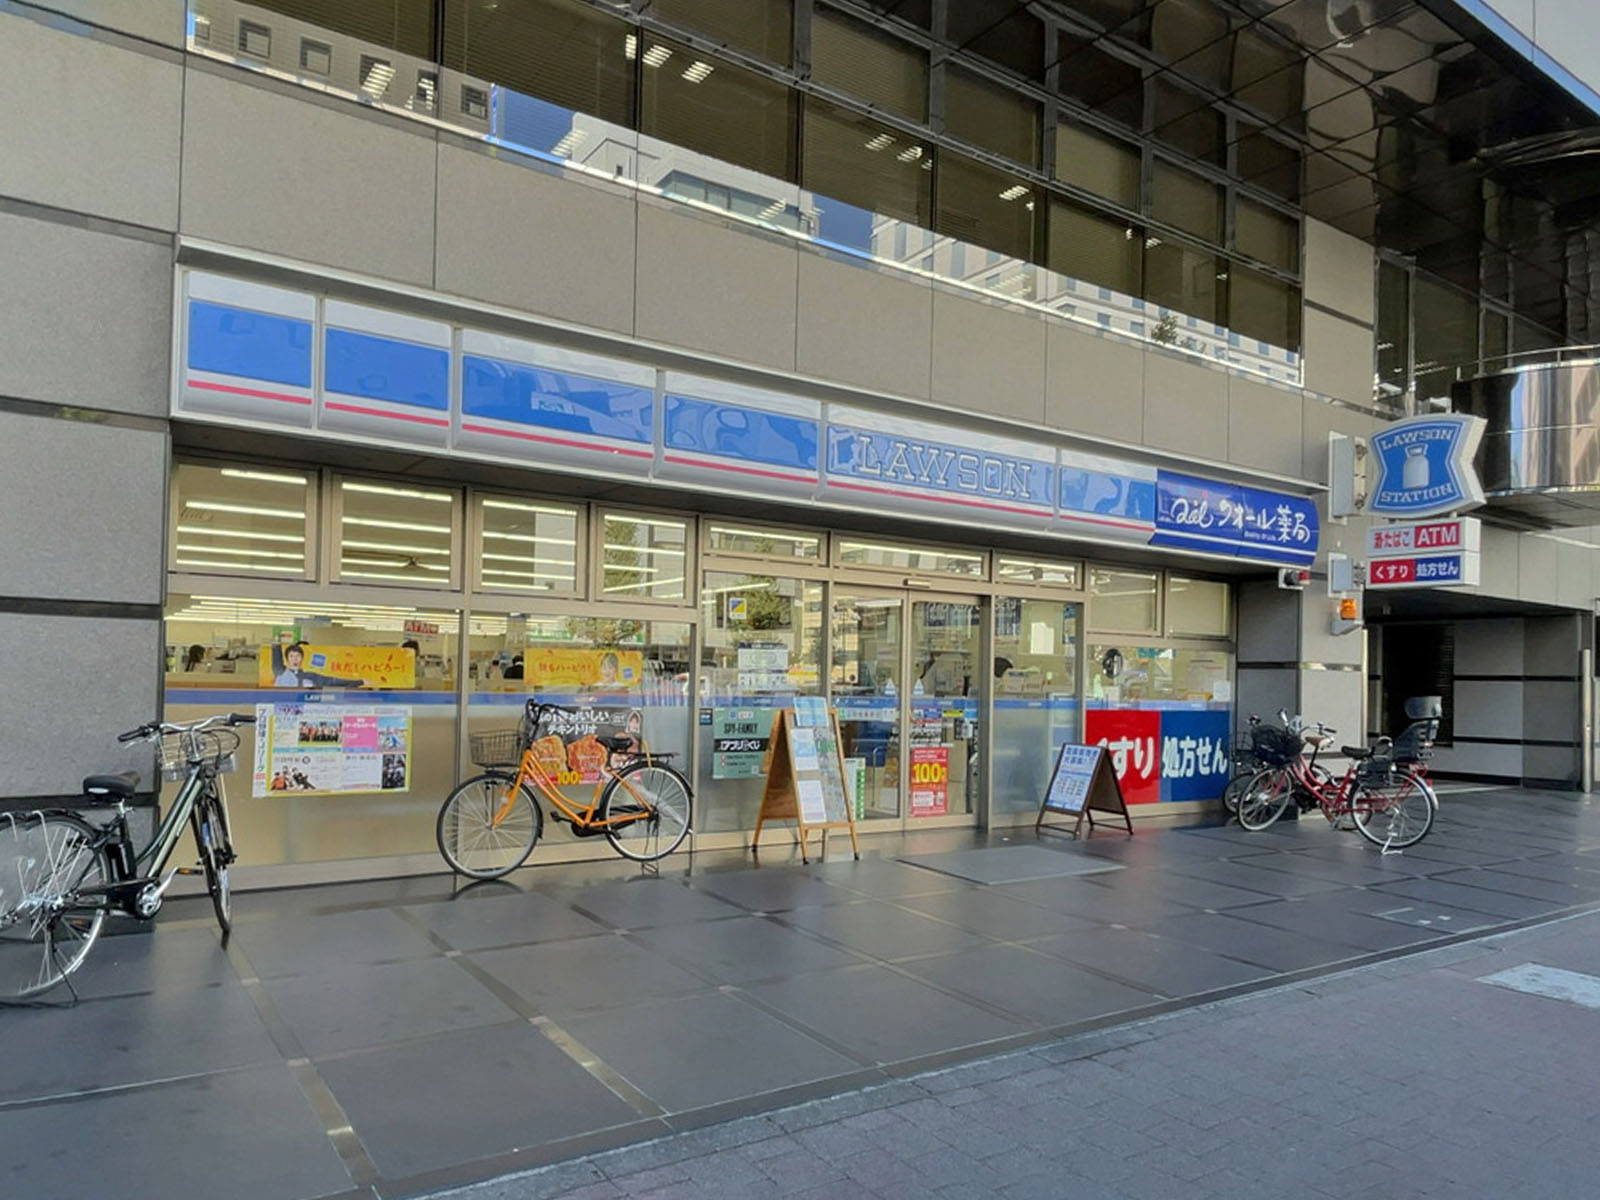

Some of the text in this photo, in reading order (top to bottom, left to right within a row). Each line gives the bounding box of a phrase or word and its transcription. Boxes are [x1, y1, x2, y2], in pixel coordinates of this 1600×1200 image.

[1381, 429, 1453, 450] LAWSON
[857, 435, 1032, 499] LAWSON
[1381, 483, 1453, 503] STATION
[1417, 526, 1458, 546] ATM
[1375, 565, 1409, 580] くすり
[1416, 561, 1459, 577] 処方せん
[547, 724, 598, 736] チキントリオ
[1161, 735, 1228, 779] 処方せん
